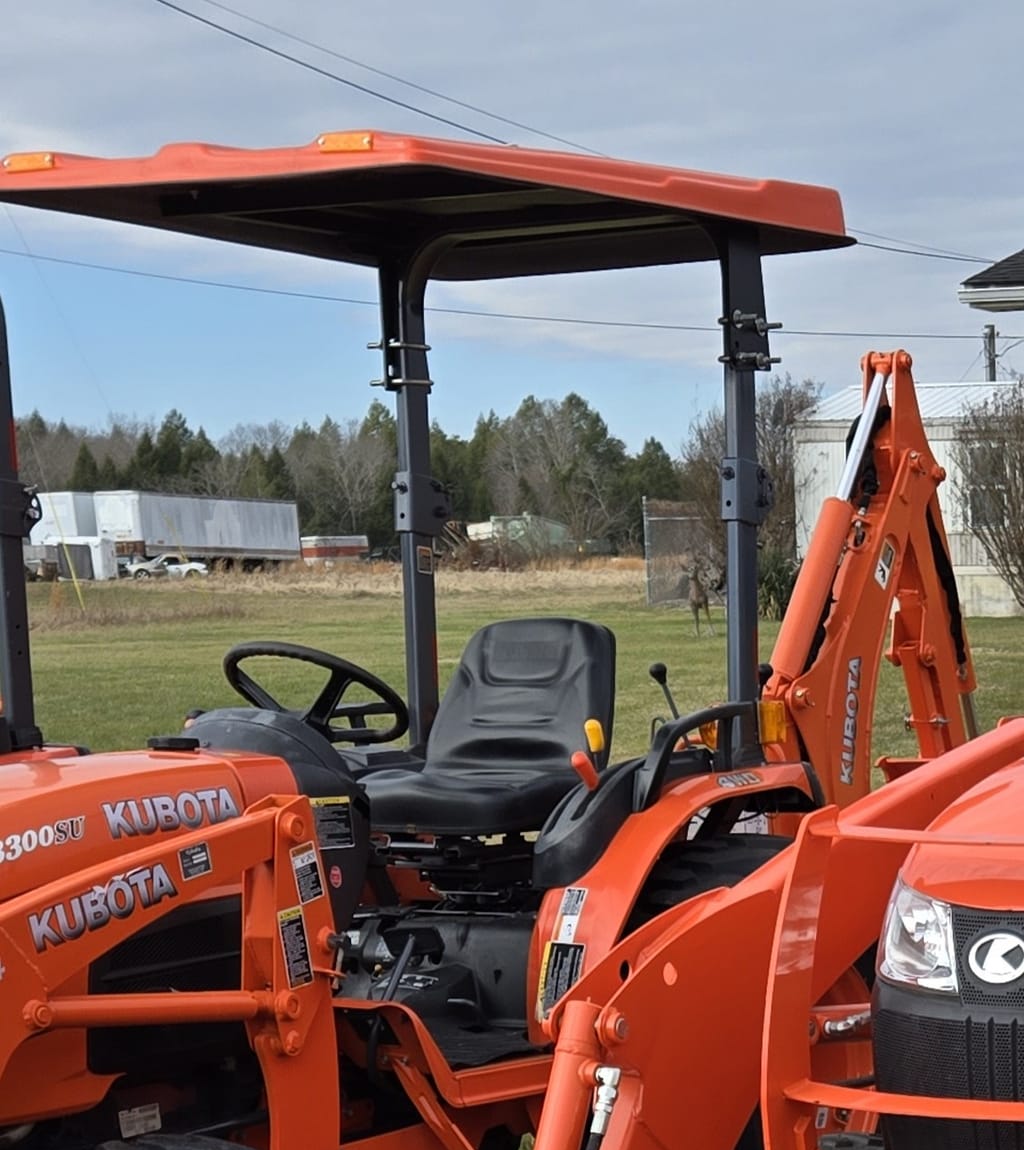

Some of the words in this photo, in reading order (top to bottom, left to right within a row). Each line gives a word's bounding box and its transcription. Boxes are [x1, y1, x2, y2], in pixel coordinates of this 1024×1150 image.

[840, 656, 861, 785] KUBOTA
[102, 787, 240, 839] KUBOTA
[27, 864, 179, 954] KUBOTA
